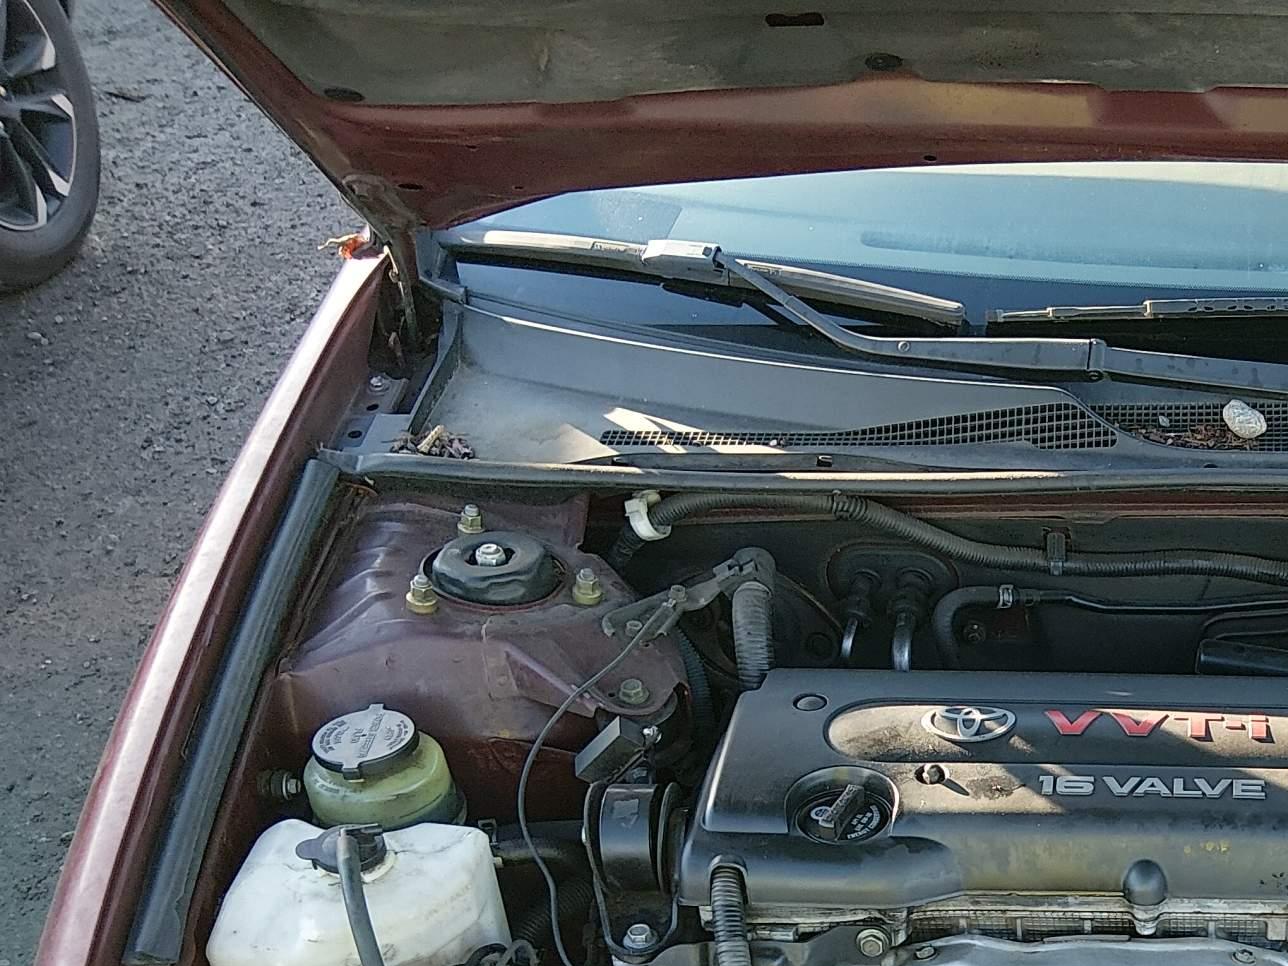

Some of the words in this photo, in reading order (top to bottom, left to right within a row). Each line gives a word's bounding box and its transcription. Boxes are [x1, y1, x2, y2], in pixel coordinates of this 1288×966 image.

[1045, 709, 1272, 741] VVT-i
[1038, 776, 1094, 796] 16
[1103, 776, 1266, 799] VALVE
